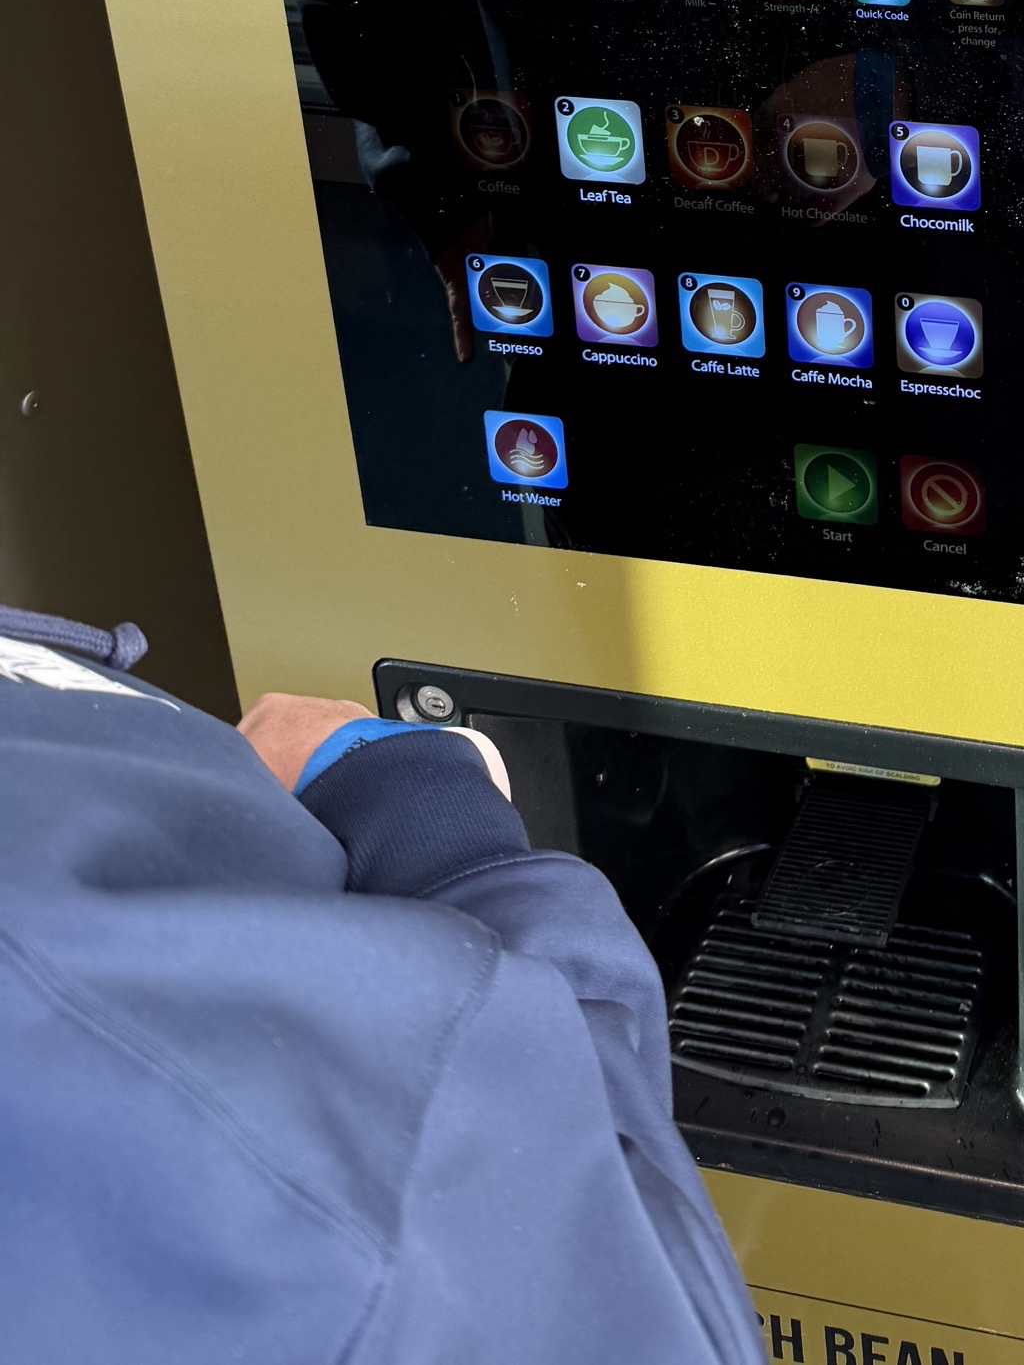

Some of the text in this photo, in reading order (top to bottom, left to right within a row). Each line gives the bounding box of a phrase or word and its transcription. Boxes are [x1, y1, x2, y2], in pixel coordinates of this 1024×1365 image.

[855, 8, 909, 21] Quick Code
[949, 9, 1005, 22] Coin Return
[958, 23, 997, 35] press for
[961, 36, 996, 48] change
[561, 102, 570, 113] 2
[672, 110, 679, 120] 3
[782, 118, 790, 129] 4
[896, 127, 904, 137] 5
[478, 180, 520, 194] Coffee
[579, 188, 632, 204] Leaf Tea
[674, 196, 754, 214] Decaff Coffee
[781, 206, 868, 224] Hot Chocolate
[900, 214, 974, 233] Chocomilk
[472, 258, 481, 269] 6
[578, 268, 586, 278] 7
[685, 277, 693, 288] 8
[793, 287, 801, 297] 9
[488, 339, 543, 356] Espresso
[582, 349, 658, 367] Cappuccino
[691, 359, 760, 378] Caffe Latte
[791, 369, 873, 389] Caffe Mocha
[900, 380, 981, 400] Espresschoc
[501, 490, 562, 507] Hot Water
[822, 528, 853, 543] Start
[923, 539, 967, 555] Cancel
[836, 764, 857, 773] AVOID
[886, 771, 920, 781] SCALDING
[757, 1312, 804, 1363] H
